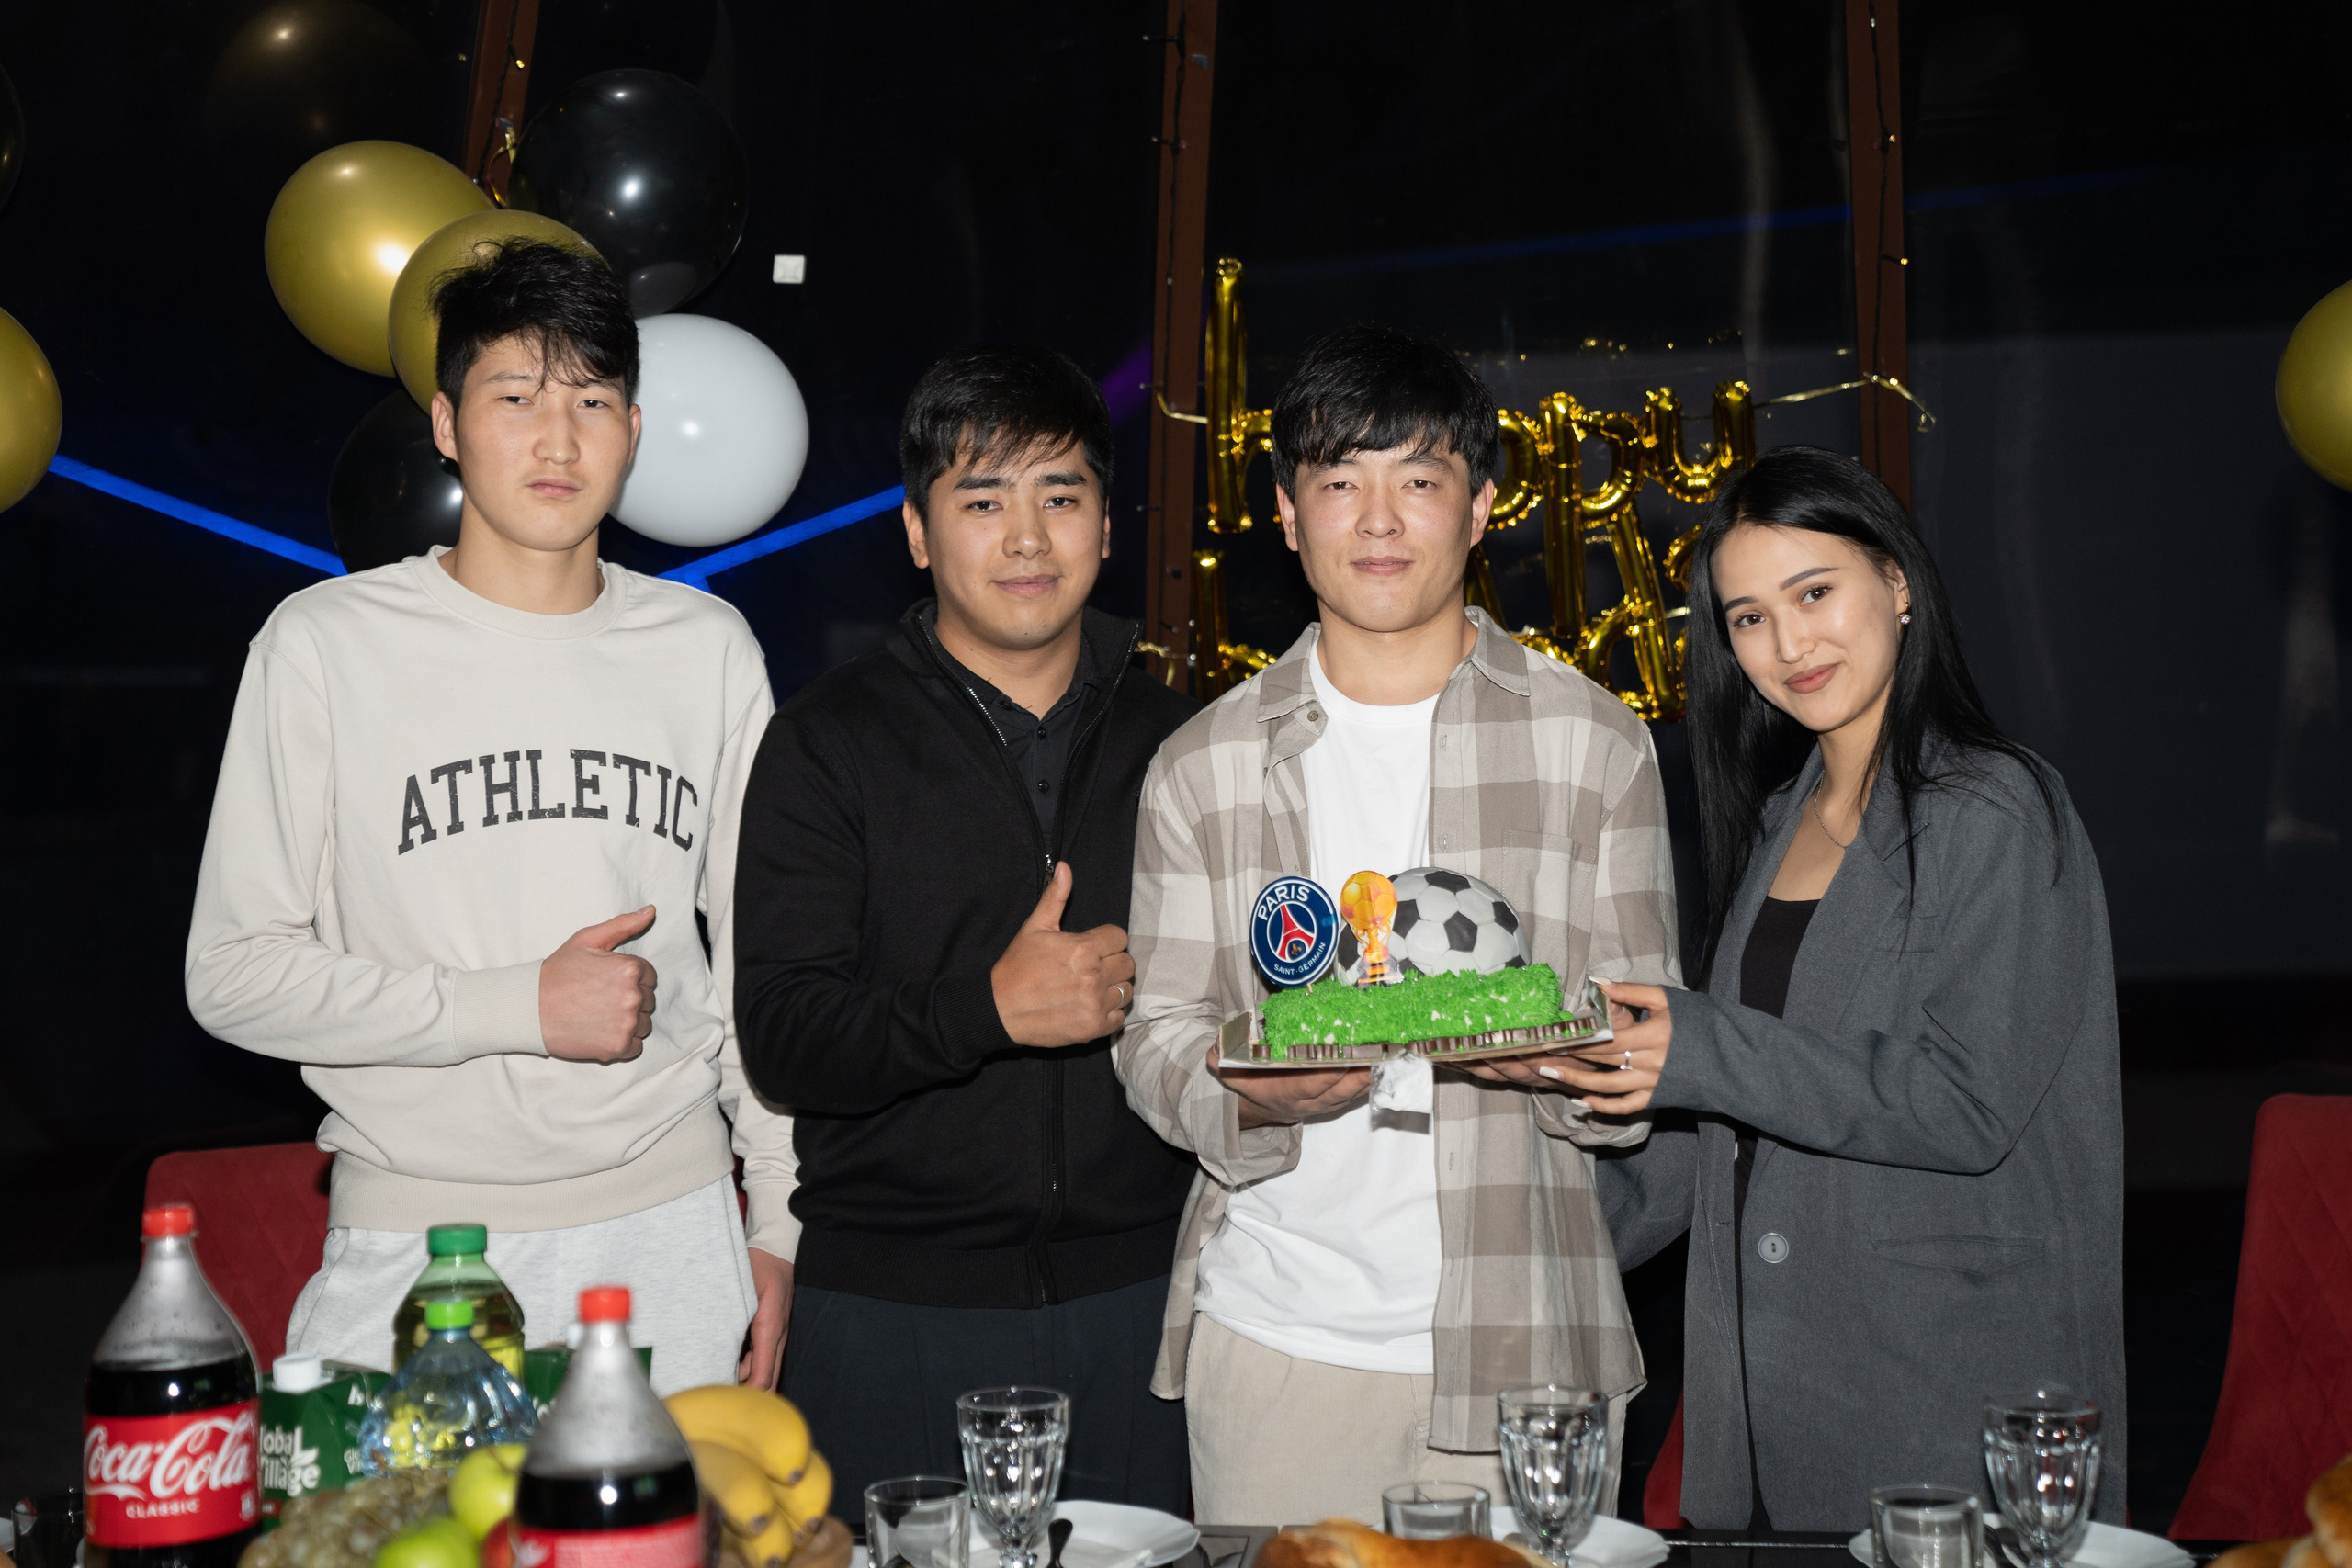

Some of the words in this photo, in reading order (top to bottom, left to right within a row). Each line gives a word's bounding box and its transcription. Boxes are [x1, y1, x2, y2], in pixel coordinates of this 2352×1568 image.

[398, 749, 697, 855] ATHLETIC
[1258, 885, 1311, 921] PARIS
[85, 1411, 254, 1499] Coca-Cola
[259, 1424, 303, 1456] lobal
[126, 1499, 200, 1518] CLASSIC
